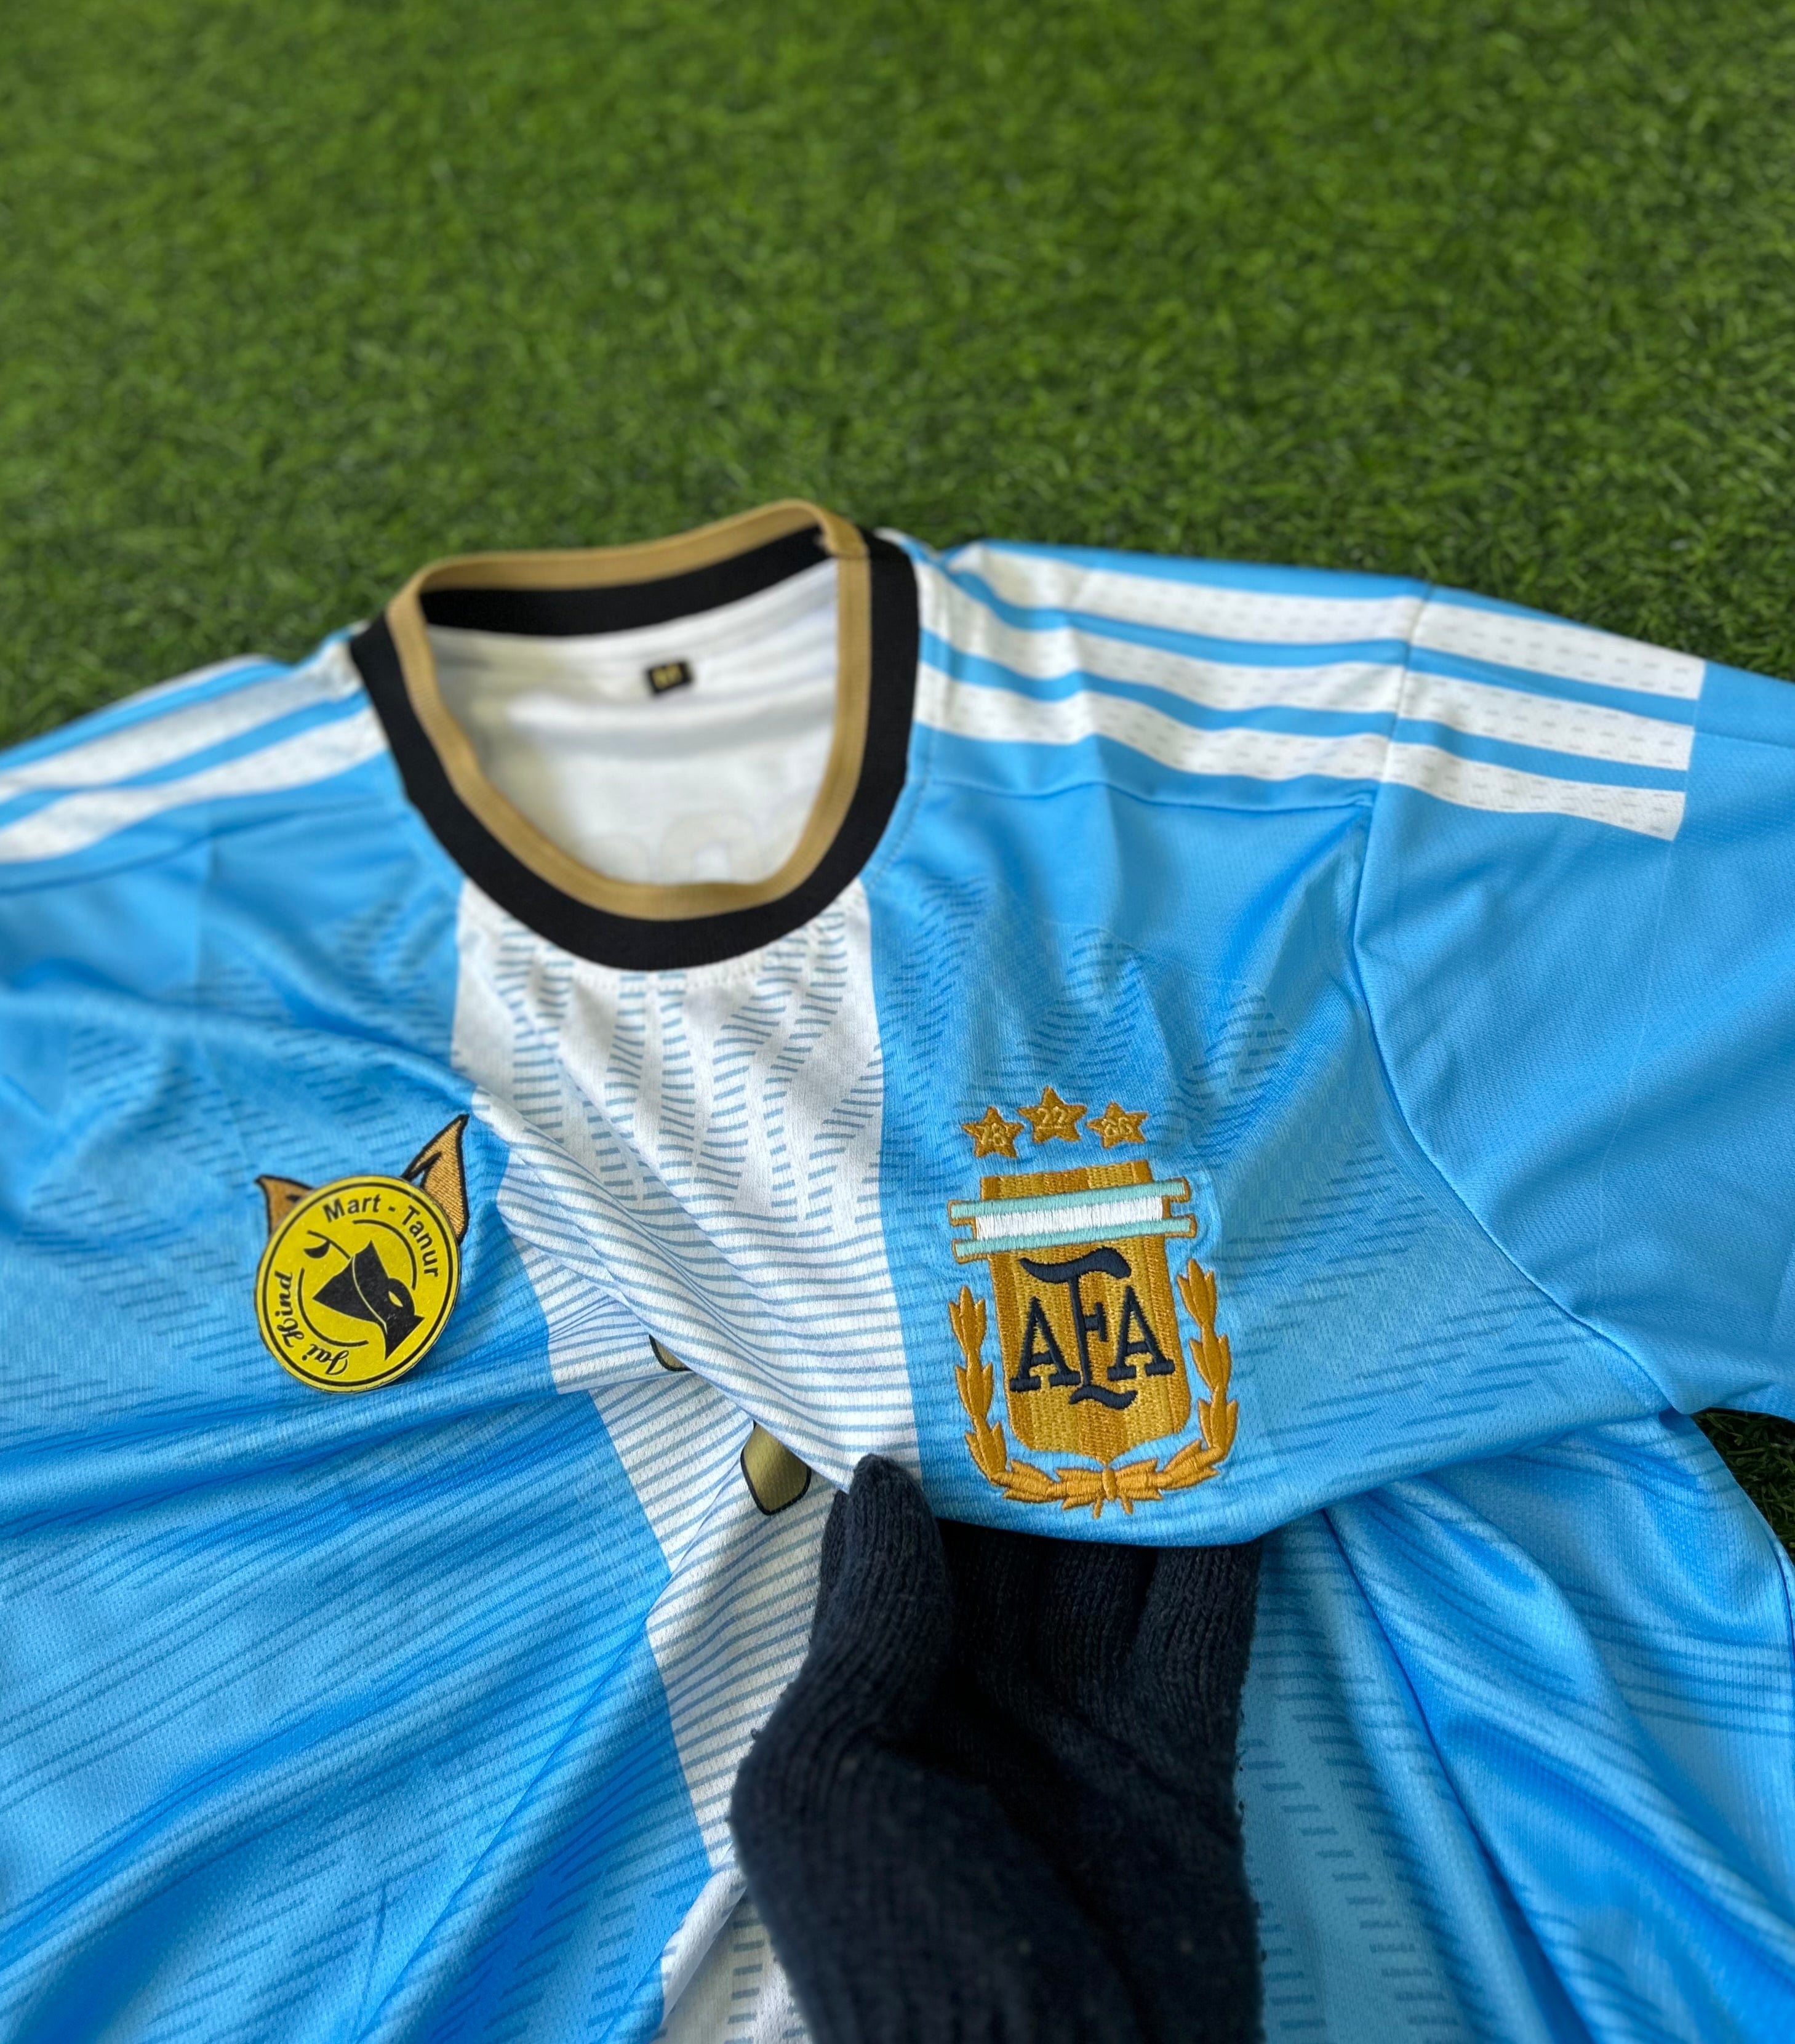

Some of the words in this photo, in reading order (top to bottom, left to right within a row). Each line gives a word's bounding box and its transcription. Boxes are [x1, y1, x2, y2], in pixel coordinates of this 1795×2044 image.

[976, 1122, 1009, 1146] 78
[1037, 1106, 1071, 1130] 22
[322, 1193, 381, 1223] Mart
[402, 1204, 439, 1277] Tanur
[274, 1270, 305, 1348] Hind
[1010, 1246, 1175, 1410] AFA
[302, 1344, 350, 1376] Jai
